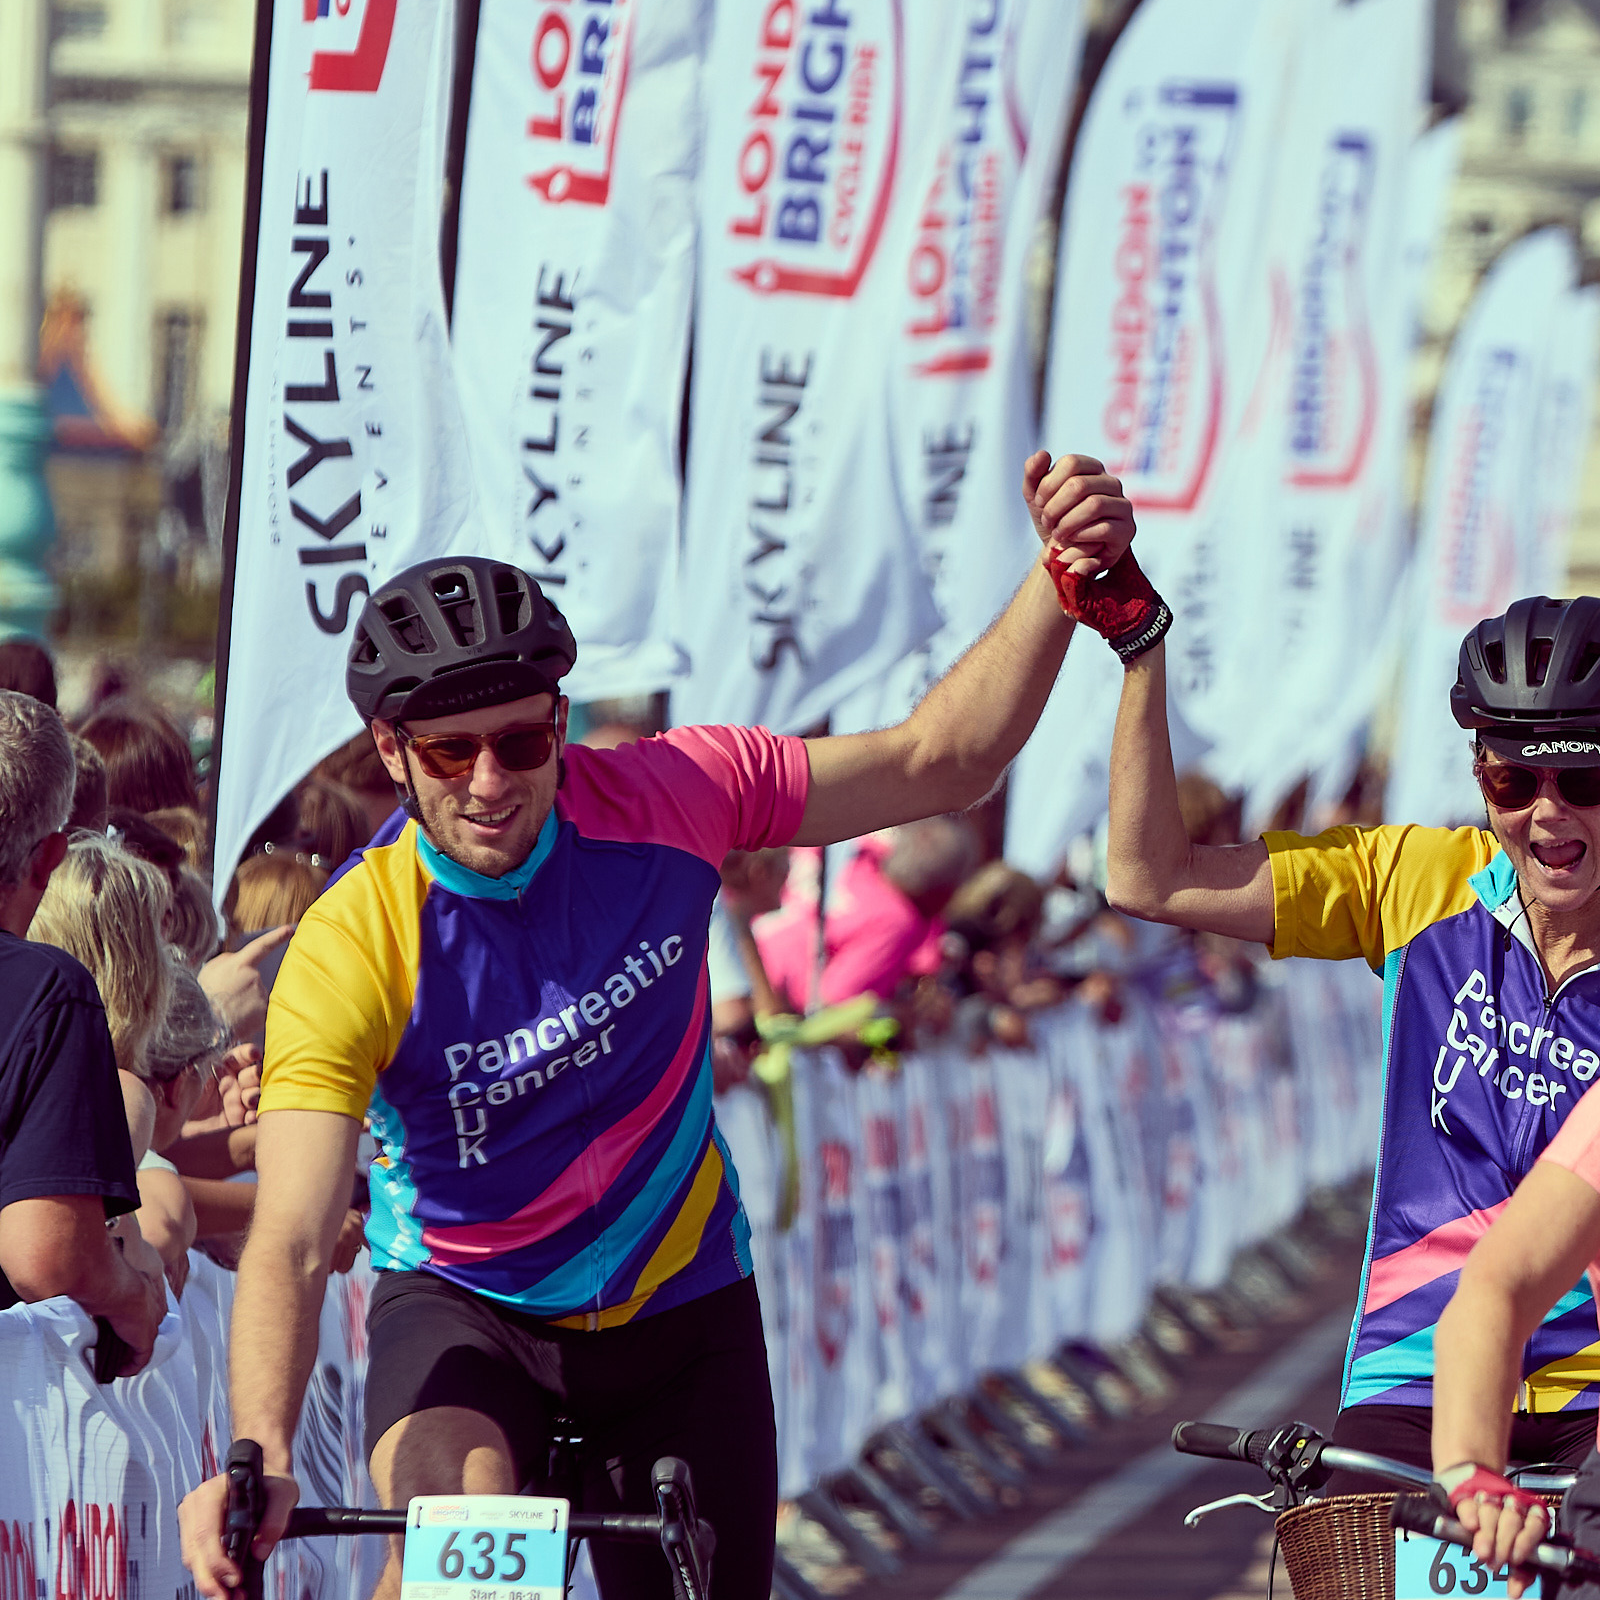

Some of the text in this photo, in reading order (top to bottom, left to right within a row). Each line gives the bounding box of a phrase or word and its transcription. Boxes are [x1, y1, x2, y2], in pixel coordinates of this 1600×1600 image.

[282, 168, 370, 636] SKYLINE
[525, 260, 583, 587] KYLINE
[746, 345, 817, 674] SKYLINE
[443, 934, 683, 1082] Pancreatic
[447, 1022, 616, 1109] Cancer
[1446, 1007, 1567, 1112] Cancer
[436, 1530, 527, 1582] 635
[508, 1510, 544, 1520] SKYLINE
